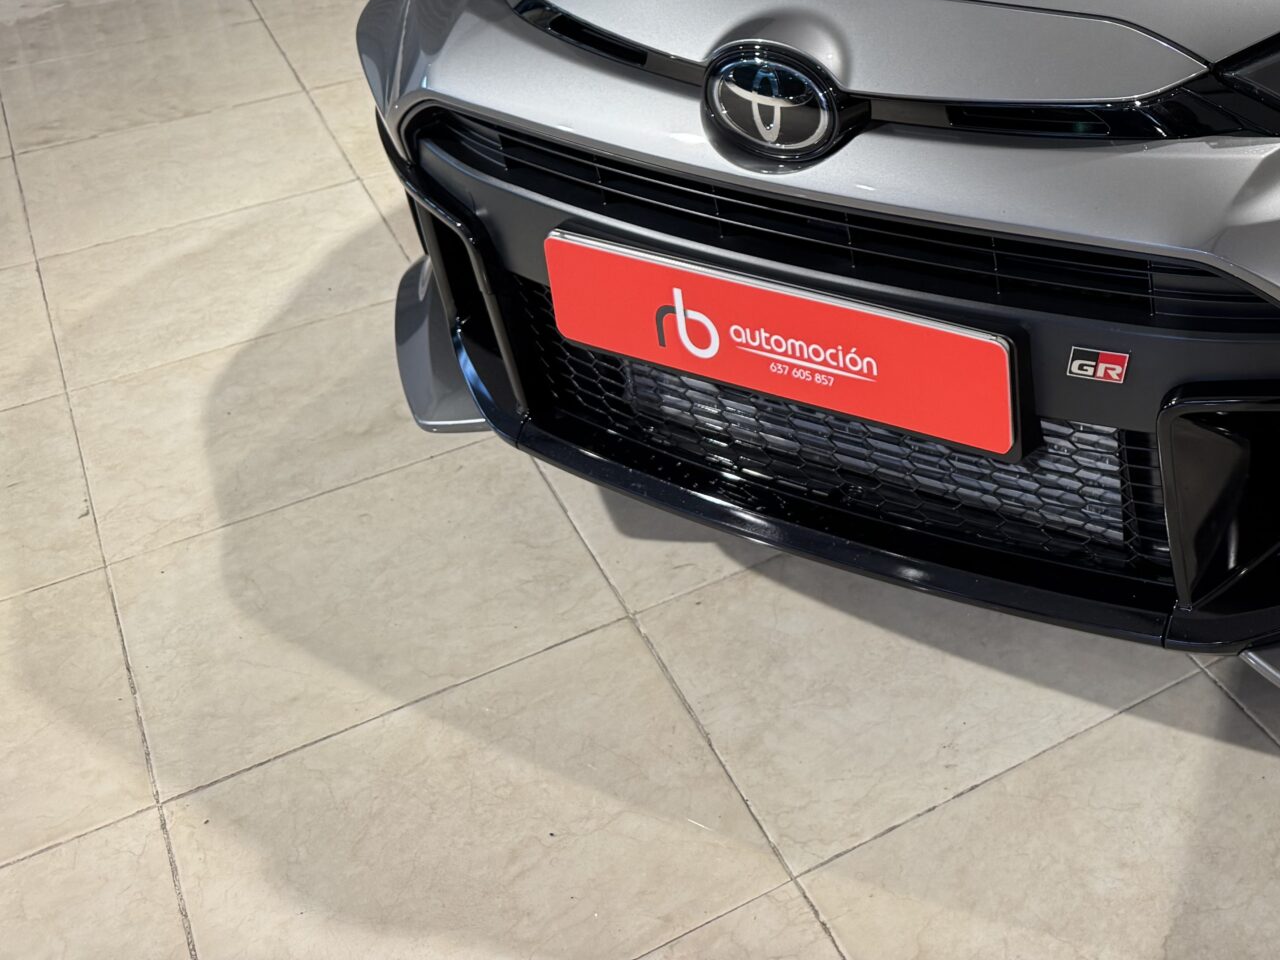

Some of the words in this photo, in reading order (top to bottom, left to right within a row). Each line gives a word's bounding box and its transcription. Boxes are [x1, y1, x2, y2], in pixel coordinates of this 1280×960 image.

[656, 287, 720, 359] rb
[729, 324, 878, 376] automoción
[769, 361, 789, 375] 637
[792, 365, 813, 381] 605
[814, 370, 834, 387] 857
[1070, 359, 1123, 381] GR
